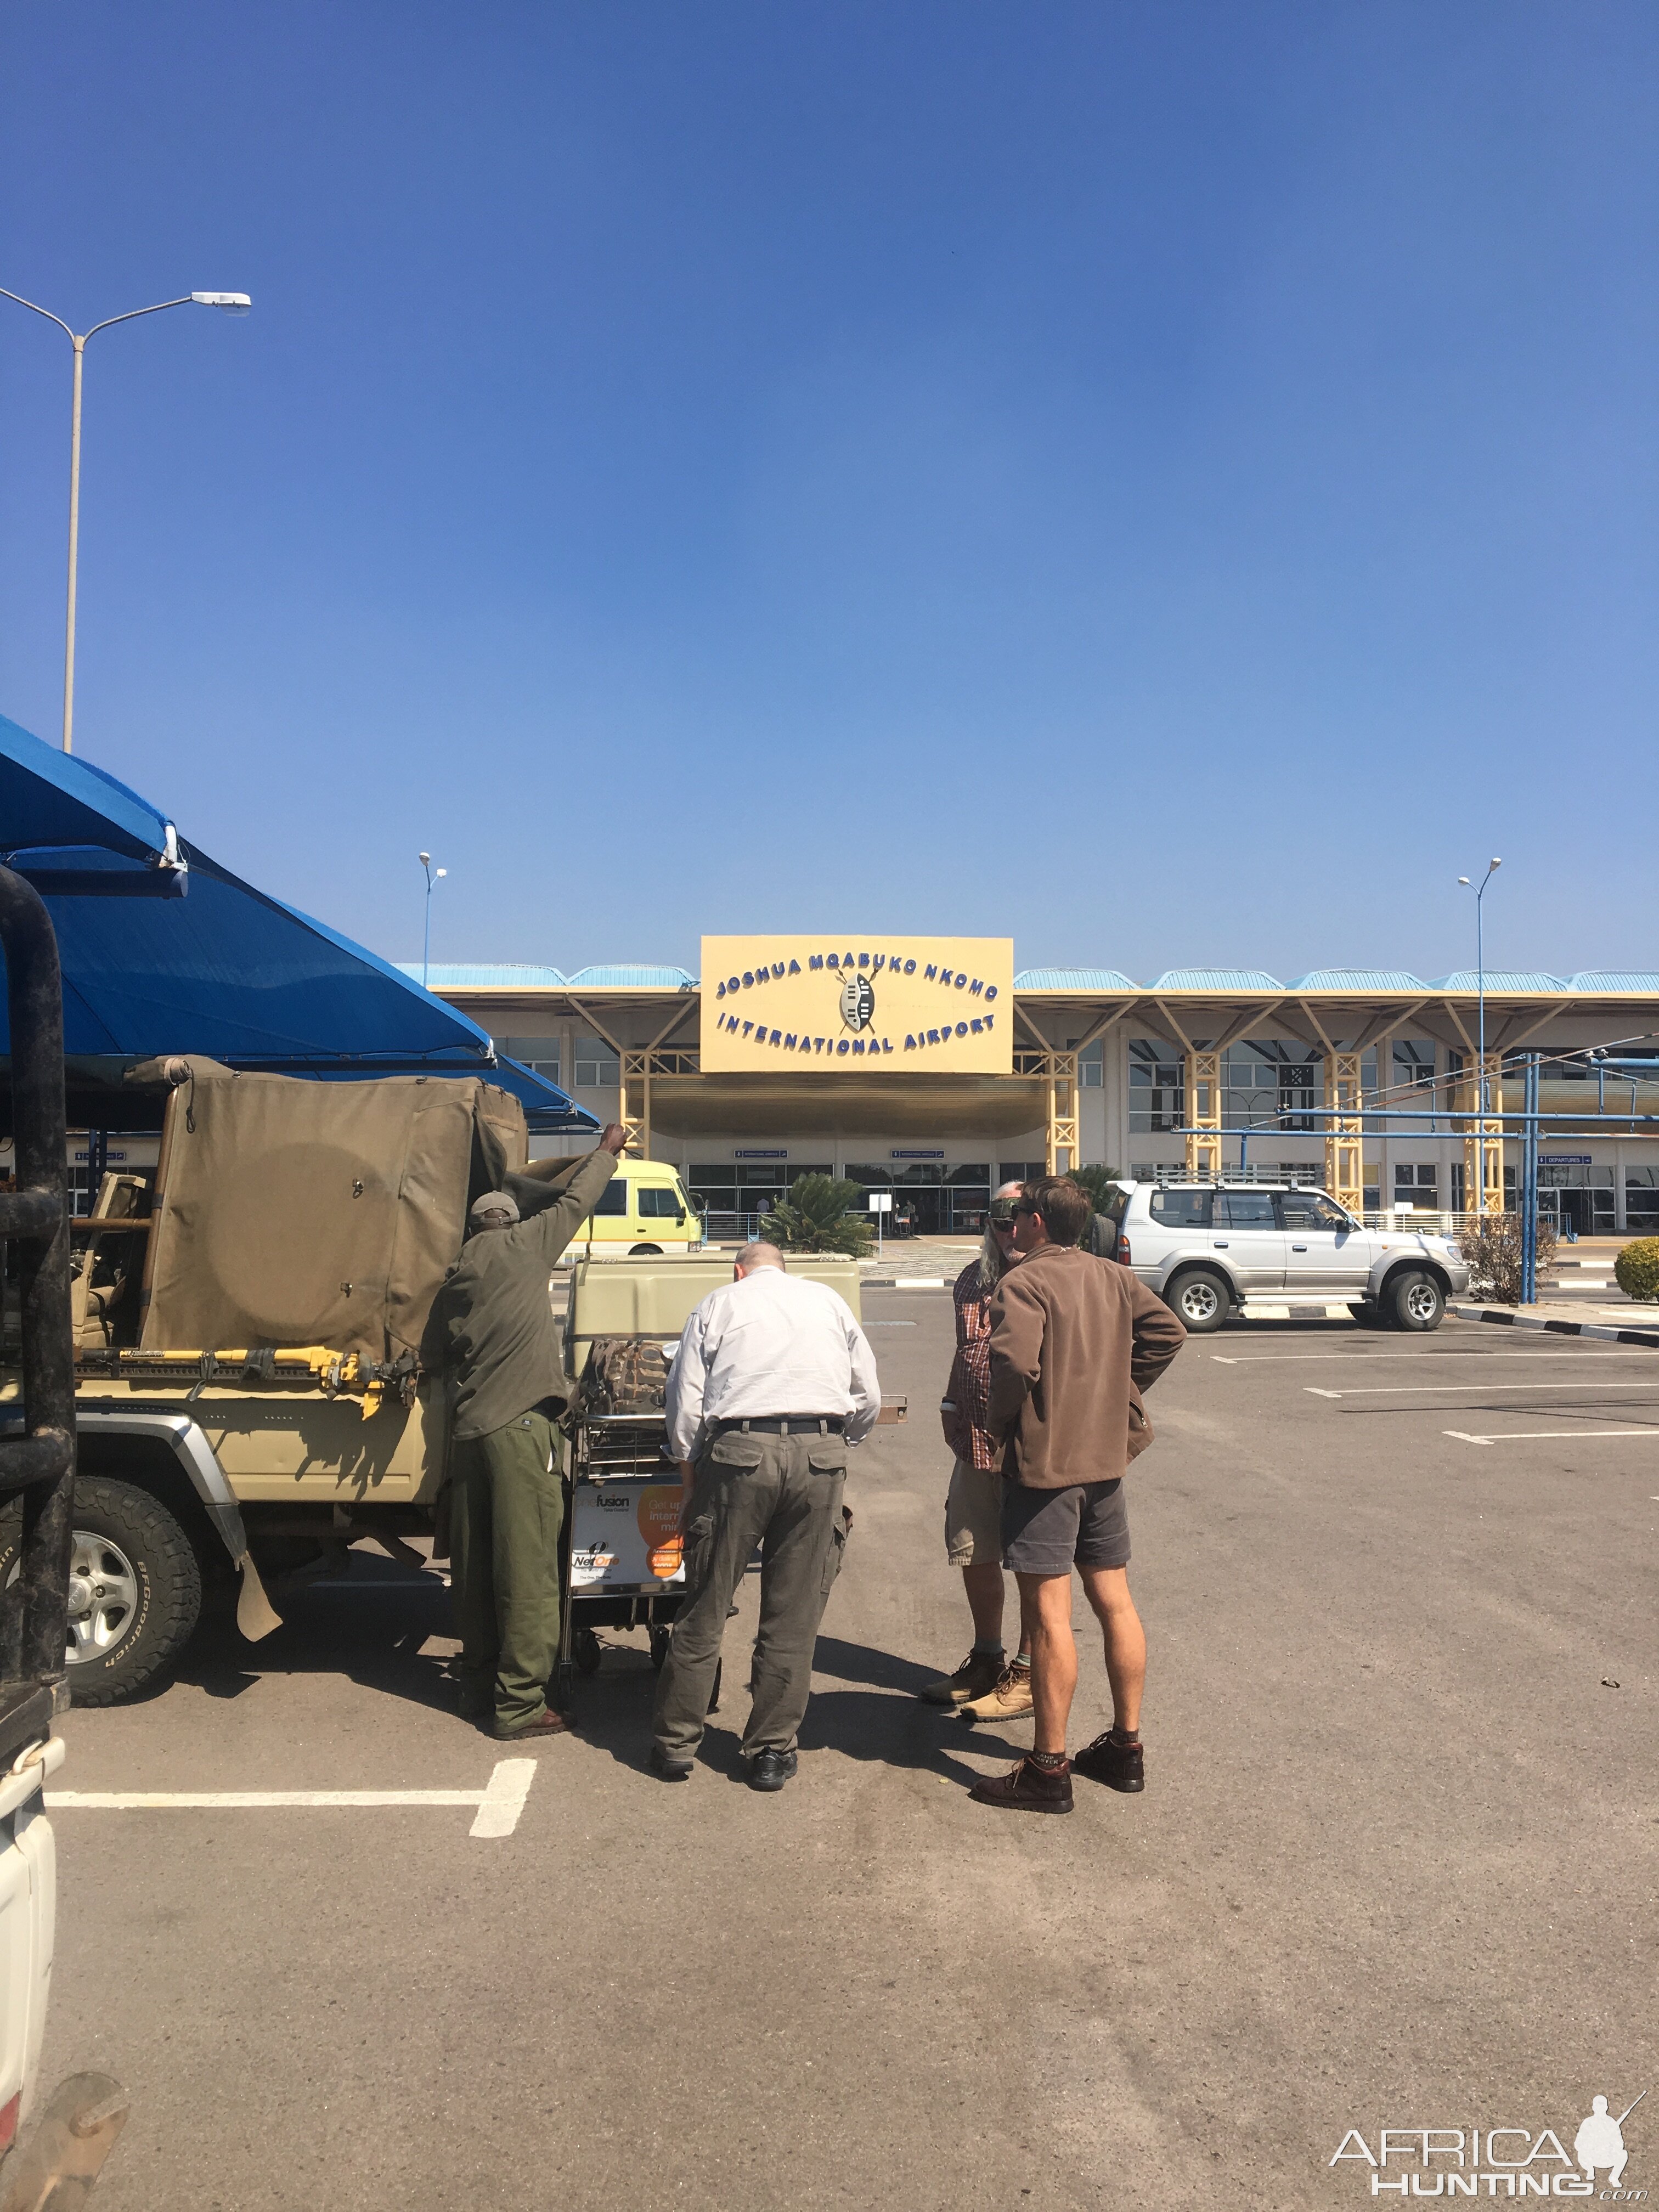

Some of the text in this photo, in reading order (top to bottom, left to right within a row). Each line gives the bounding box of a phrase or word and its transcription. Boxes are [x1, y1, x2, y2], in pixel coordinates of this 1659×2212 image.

[716, 952, 998, 1001] JOSHUA MQABUKO NKOMO
[716, 1012, 994, 1054] INTERNATIONAL AIRPORT
[574, 1555, 620, 1566] NetOne
[106, 1561, 150, 1668] BFGoodrich
